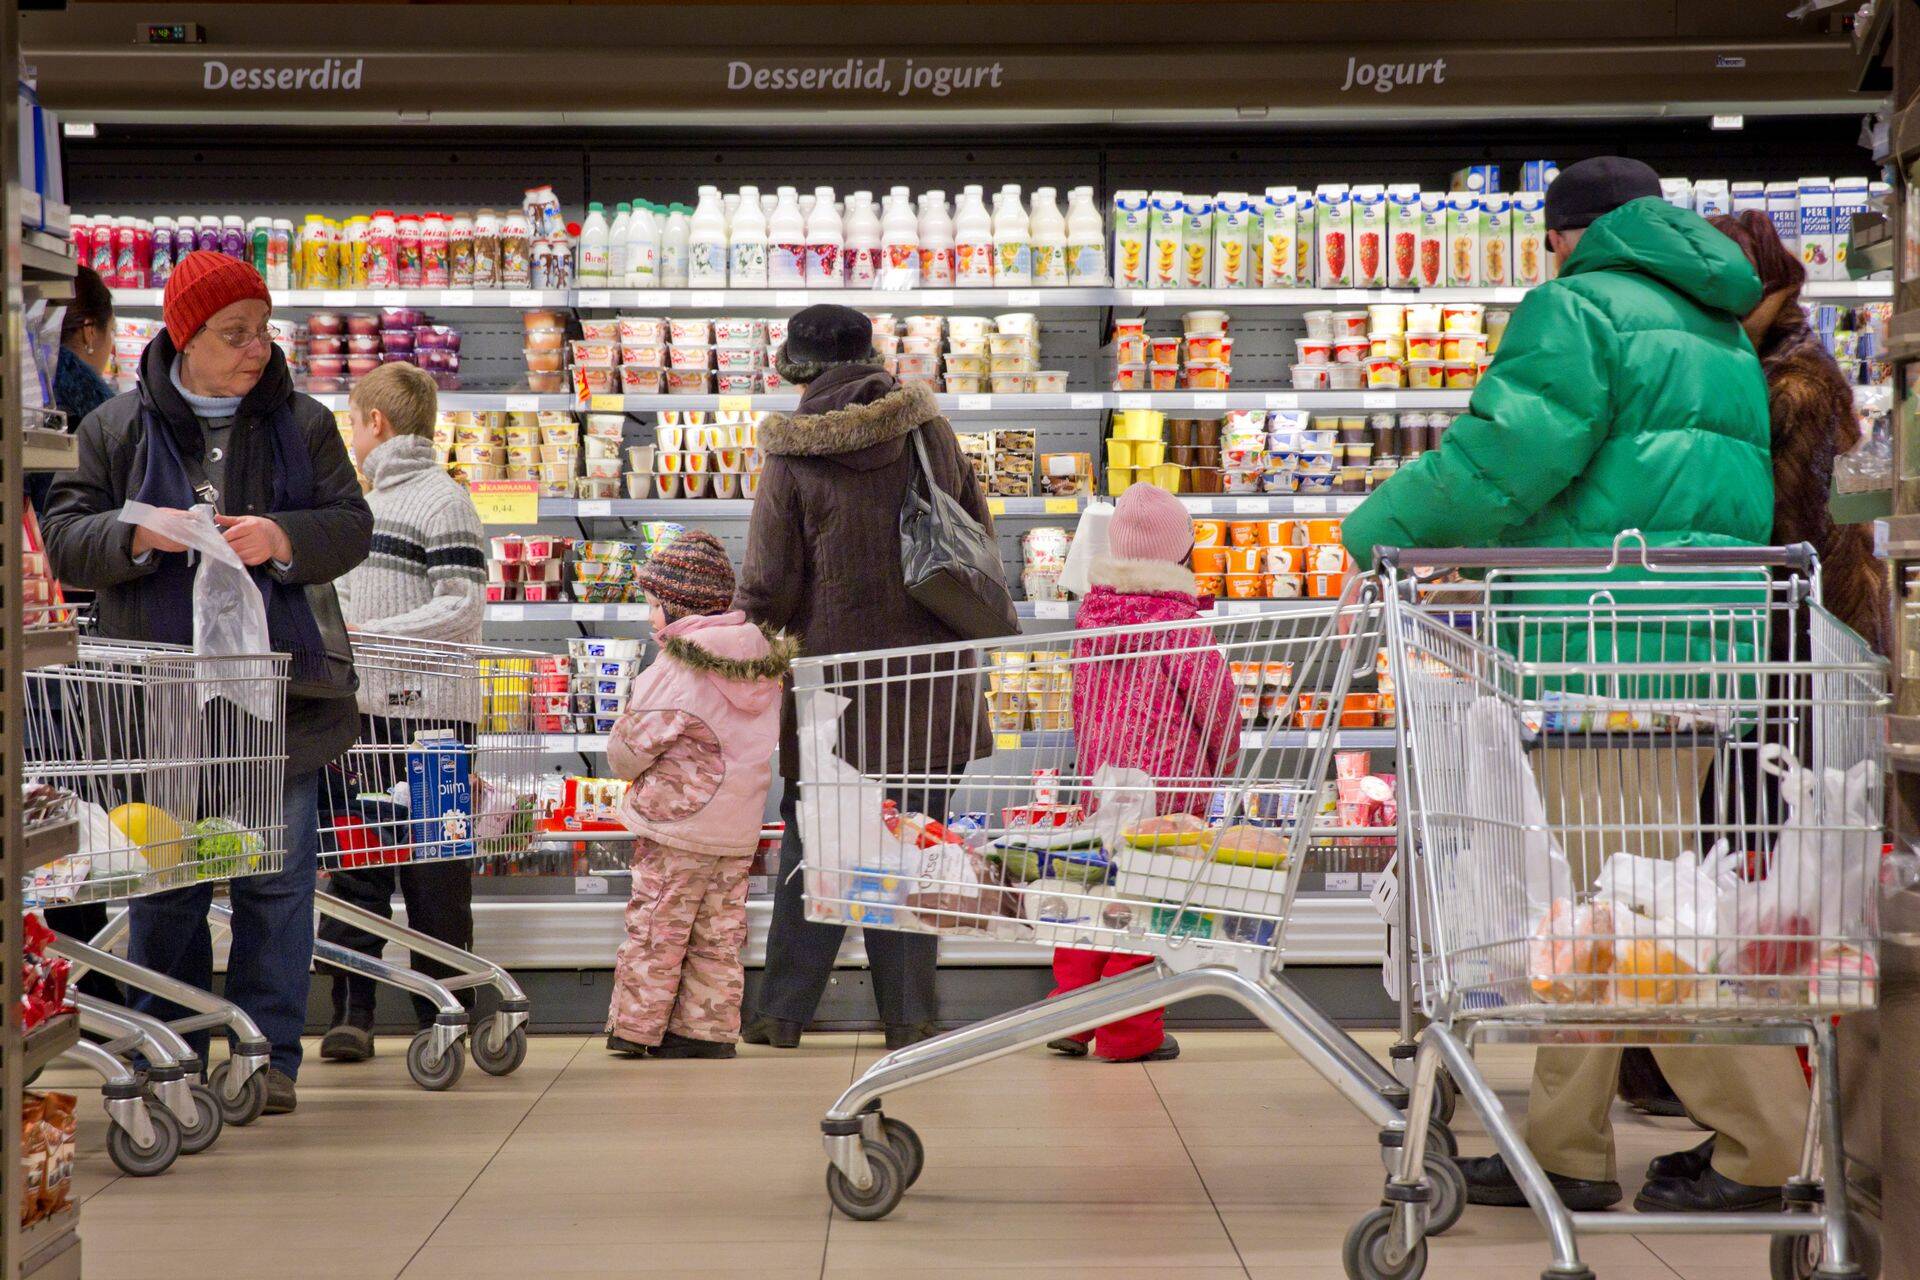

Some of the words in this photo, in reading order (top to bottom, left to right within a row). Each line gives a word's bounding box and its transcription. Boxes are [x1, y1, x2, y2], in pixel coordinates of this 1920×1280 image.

[203, 58, 364, 90] Desserdid
[727, 58, 892, 93] Desserdid,
[898, 59, 1004, 97] jogurt
[1341, 56, 1447, 93] Jogurt
[1774, 211, 1795, 221] PERE
[1806, 207, 1828, 216] PERE
[585, 251, 606, 264] Airan
[485, 483, 533, 492] KAMPAANIA
[439, 780, 466, 796] piim
